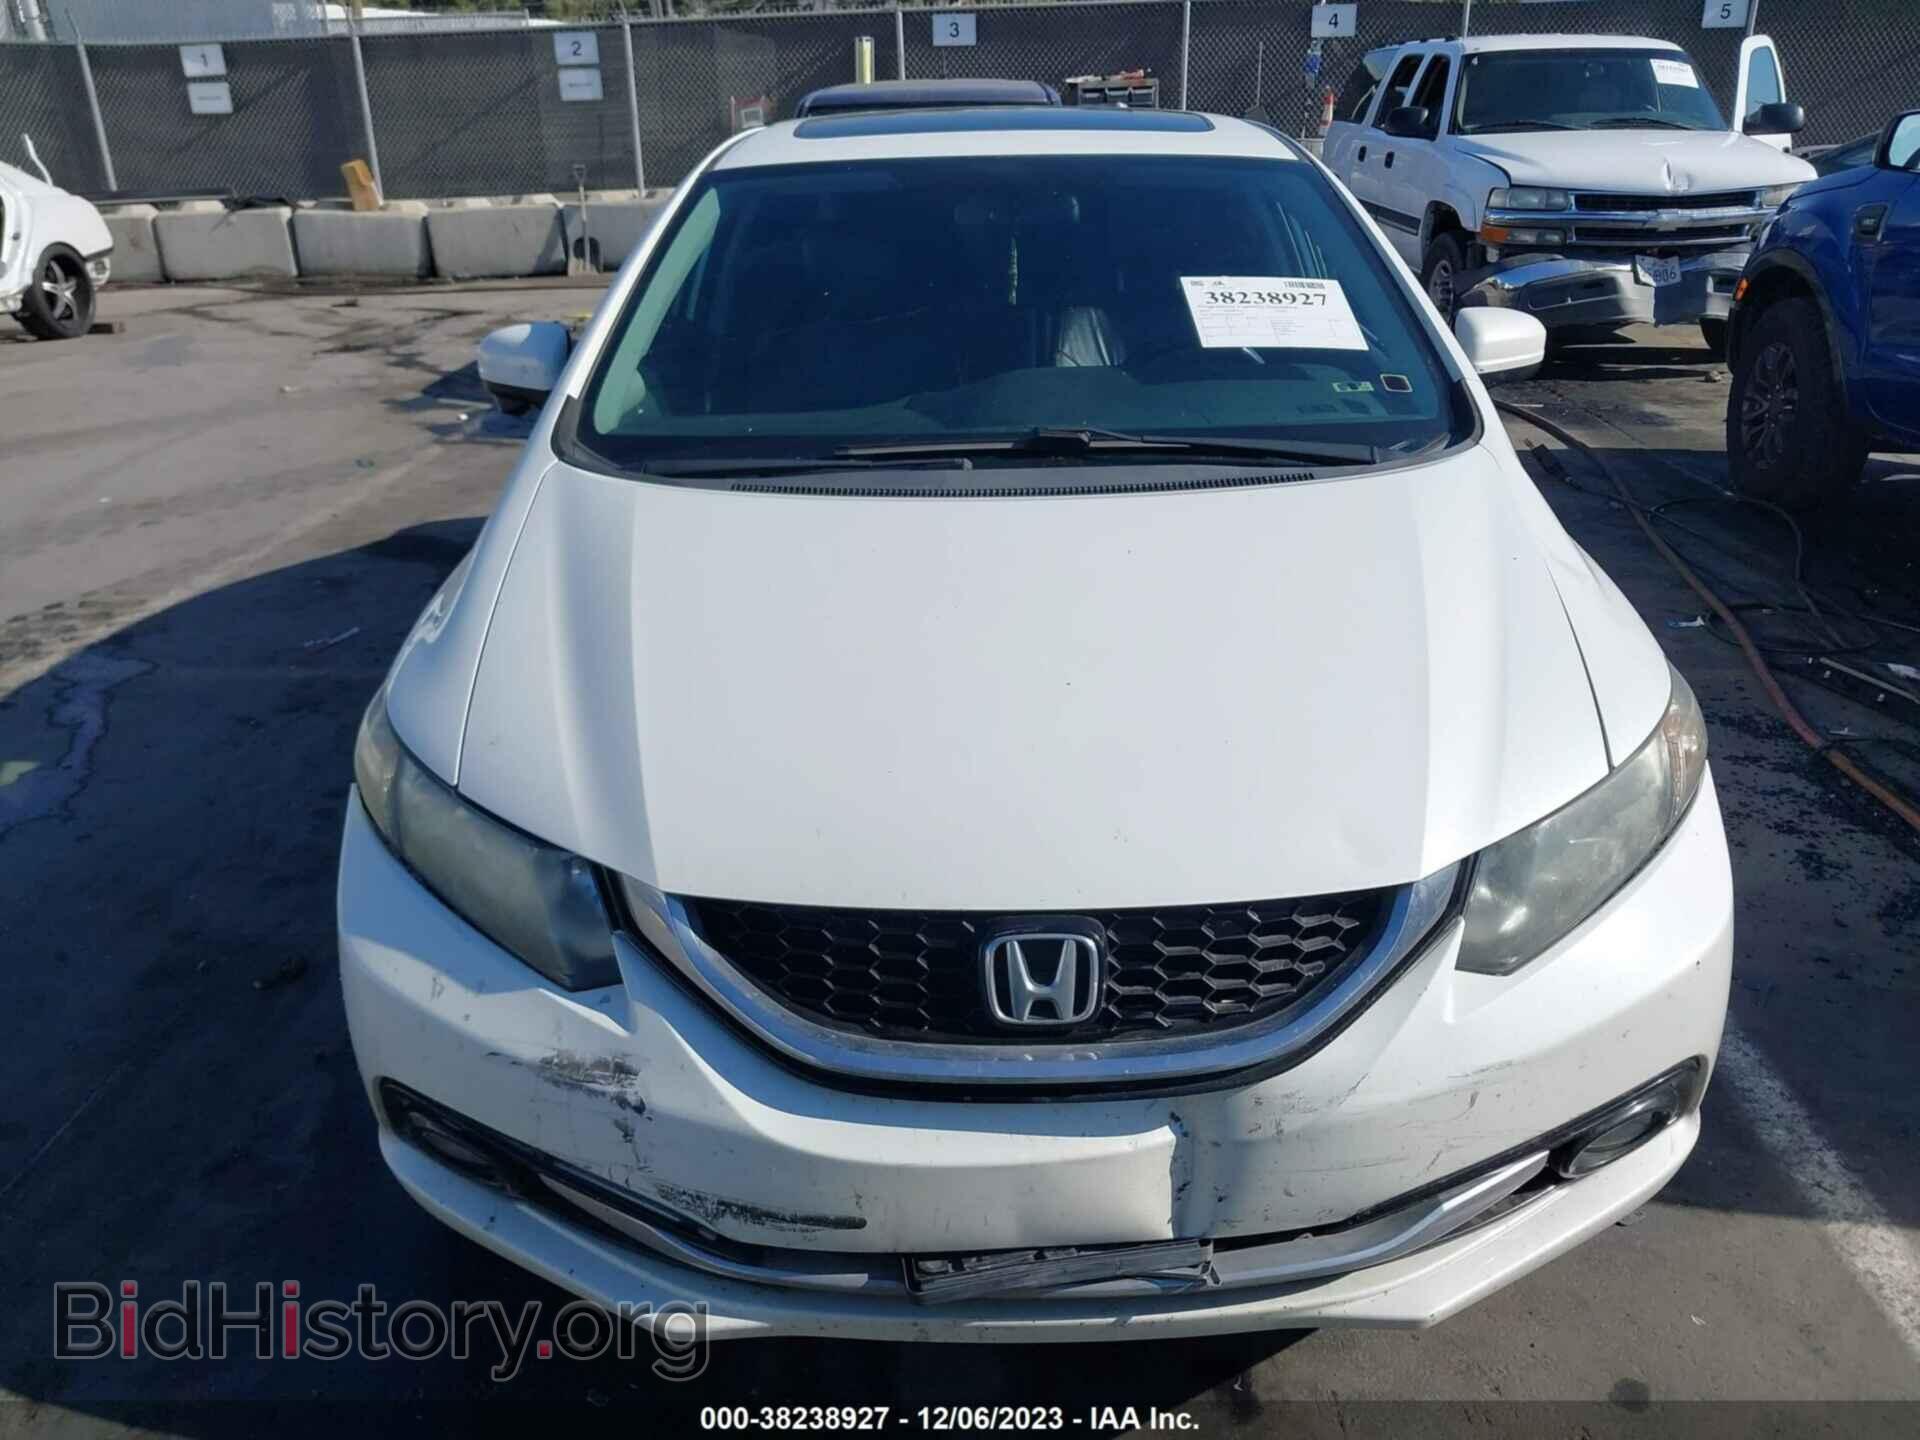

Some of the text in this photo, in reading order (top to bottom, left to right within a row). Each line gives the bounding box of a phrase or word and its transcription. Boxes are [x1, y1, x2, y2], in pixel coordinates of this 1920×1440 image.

[1720, 3, 1731, 20] 5
[1328, 12, 1339, 29] 4
[949, 22, 960, 38] 3
[570, 40, 583, 57] 2
[200, 53, 209, 69] 1
[1204, 290, 1327, 306] 38238927
